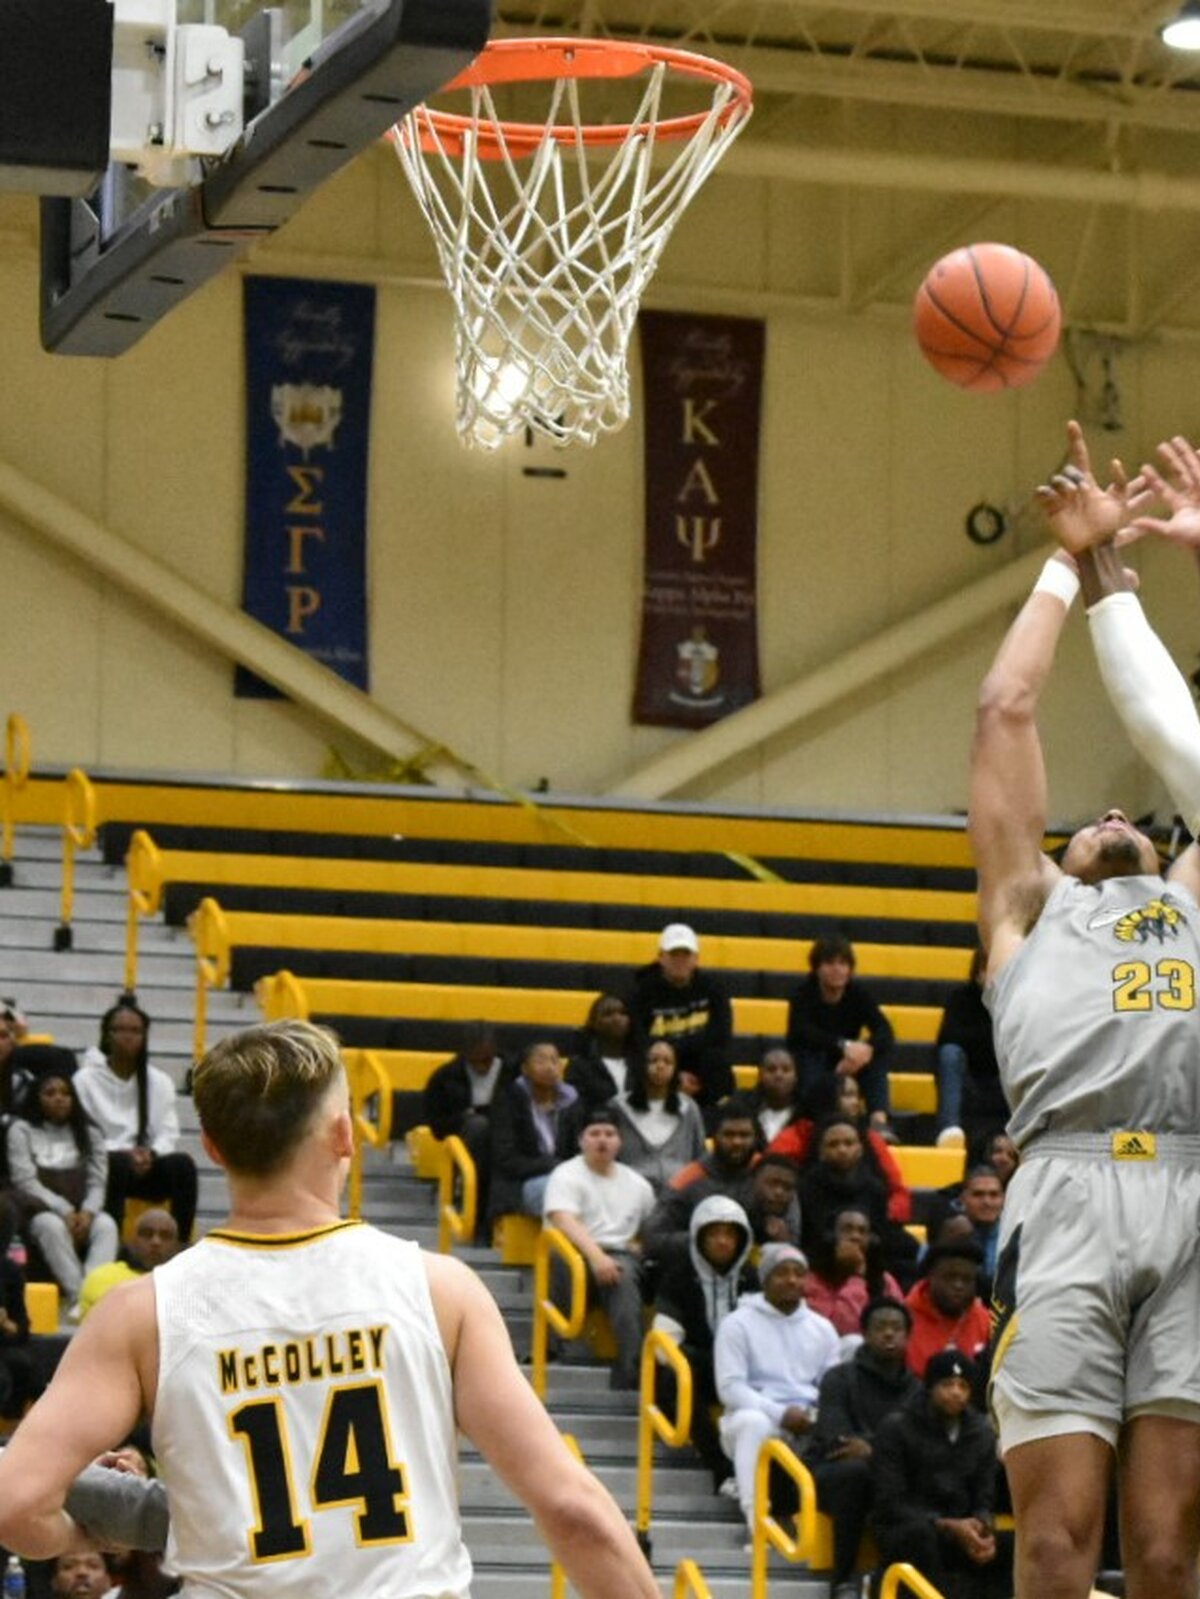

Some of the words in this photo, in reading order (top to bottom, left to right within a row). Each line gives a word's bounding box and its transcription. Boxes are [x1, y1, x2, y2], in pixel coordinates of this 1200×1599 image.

[965, 502, 1005, 545] O
[1112, 958, 1196, 1012] 23
[217, 1326, 388, 1393] McCOLLEY
[227, 1378, 415, 1565] 14
